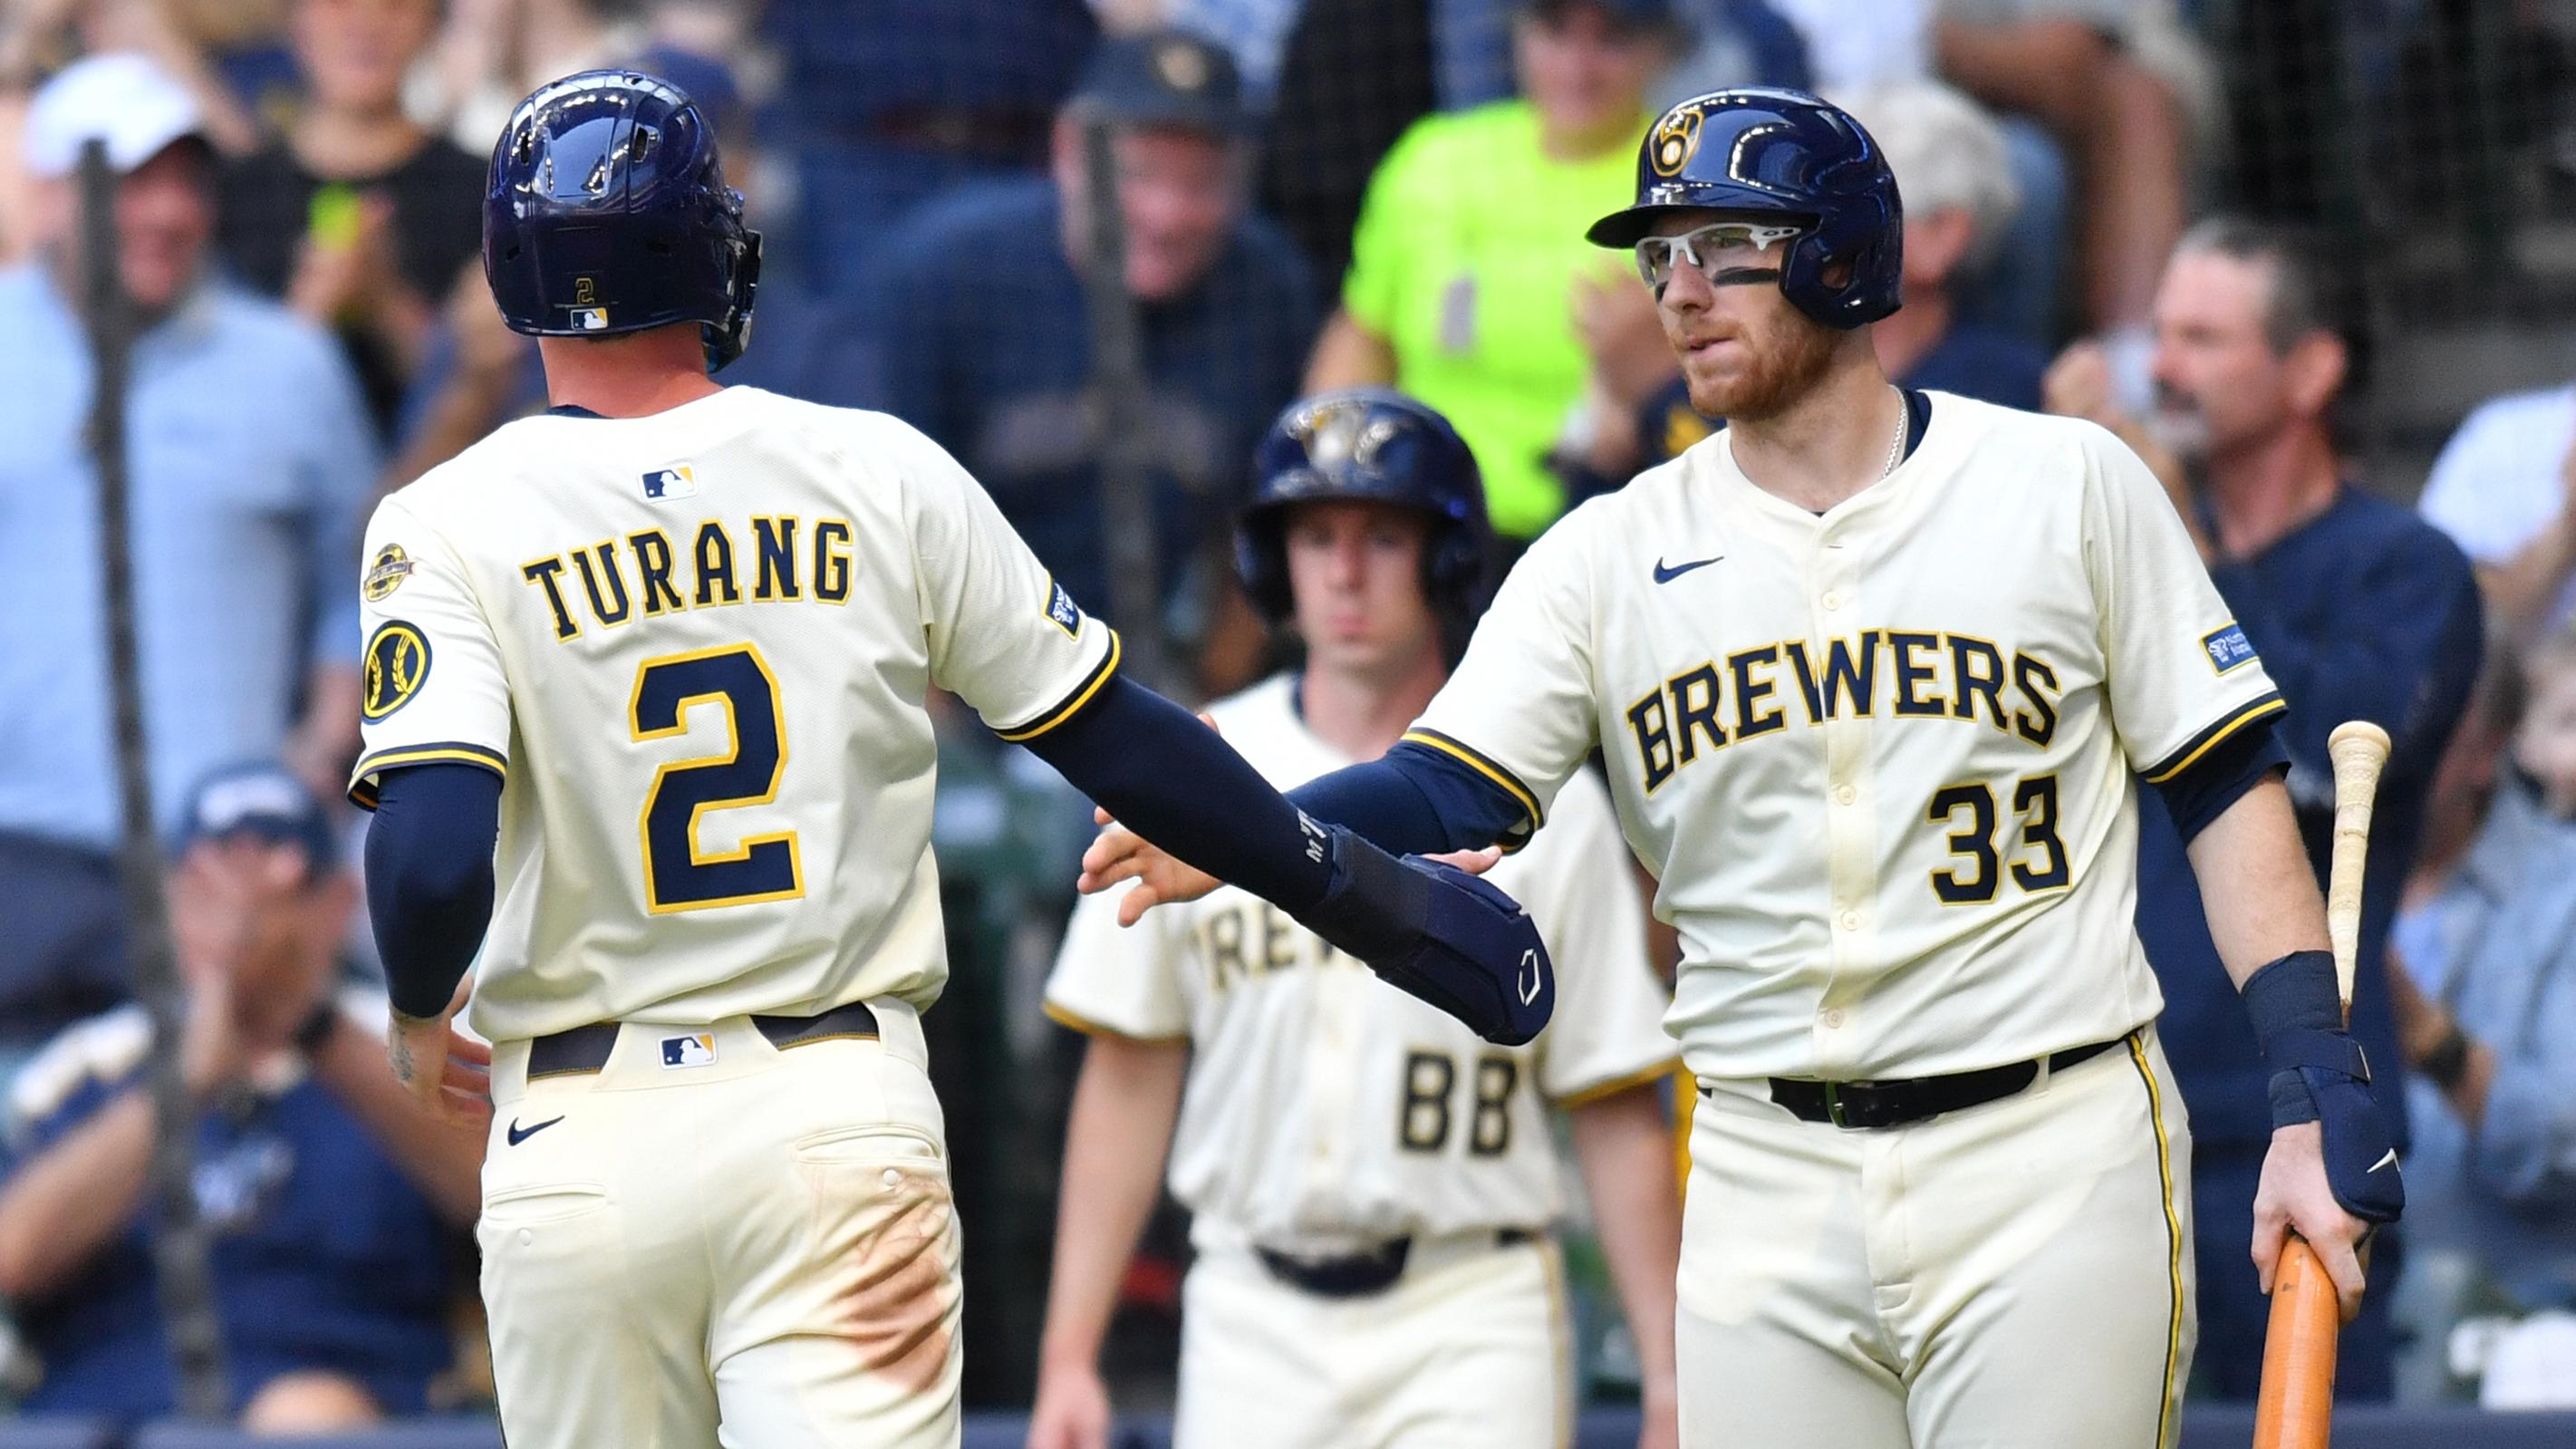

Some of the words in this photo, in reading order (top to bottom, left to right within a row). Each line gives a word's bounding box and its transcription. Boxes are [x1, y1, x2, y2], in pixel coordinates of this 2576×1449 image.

[574, 276, 595, 305] 2
[520, 515, 854, 644] TURANG
[627, 641, 806, 915] 2
[1626, 628, 2061, 797] BREWERS
[1928, 772, 2073, 906] 33
[1398, 1050, 1518, 1157] 88
